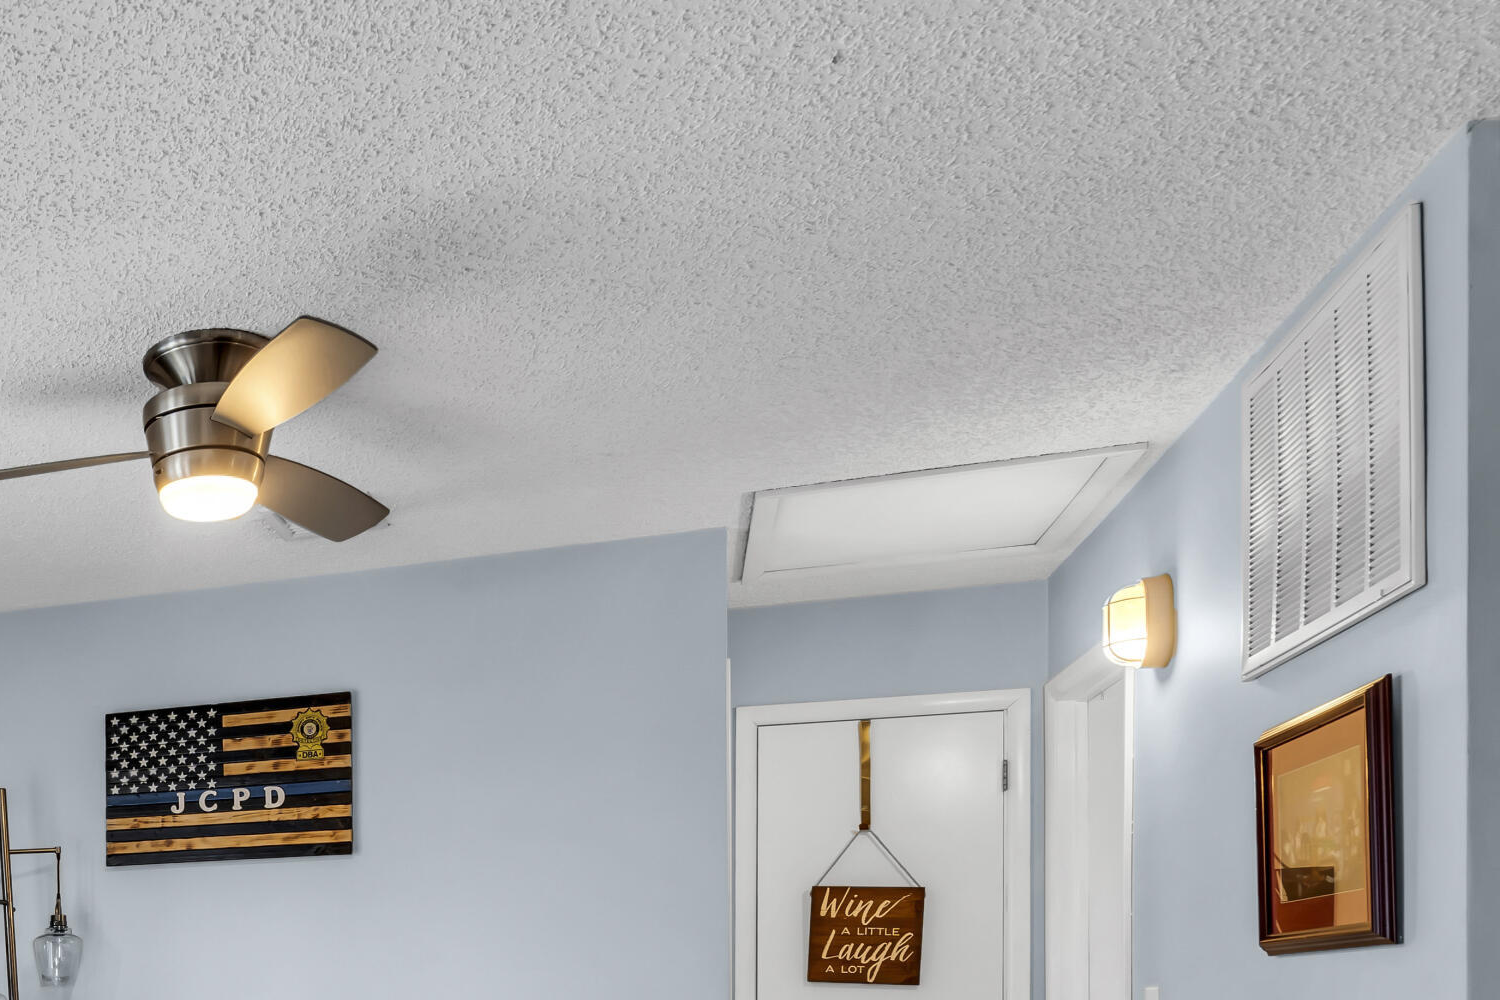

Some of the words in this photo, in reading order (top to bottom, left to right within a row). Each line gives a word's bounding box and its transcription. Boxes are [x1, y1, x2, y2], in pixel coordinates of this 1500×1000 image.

[820, 887, 912, 926] Wine
[841, 927, 850, 935] A
[857, 928, 900, 936] LITTLE
[821, 929, 914, 983] Laugh
[825, 964, 835, 974] A
[840, 965, 866, 974] LOT
